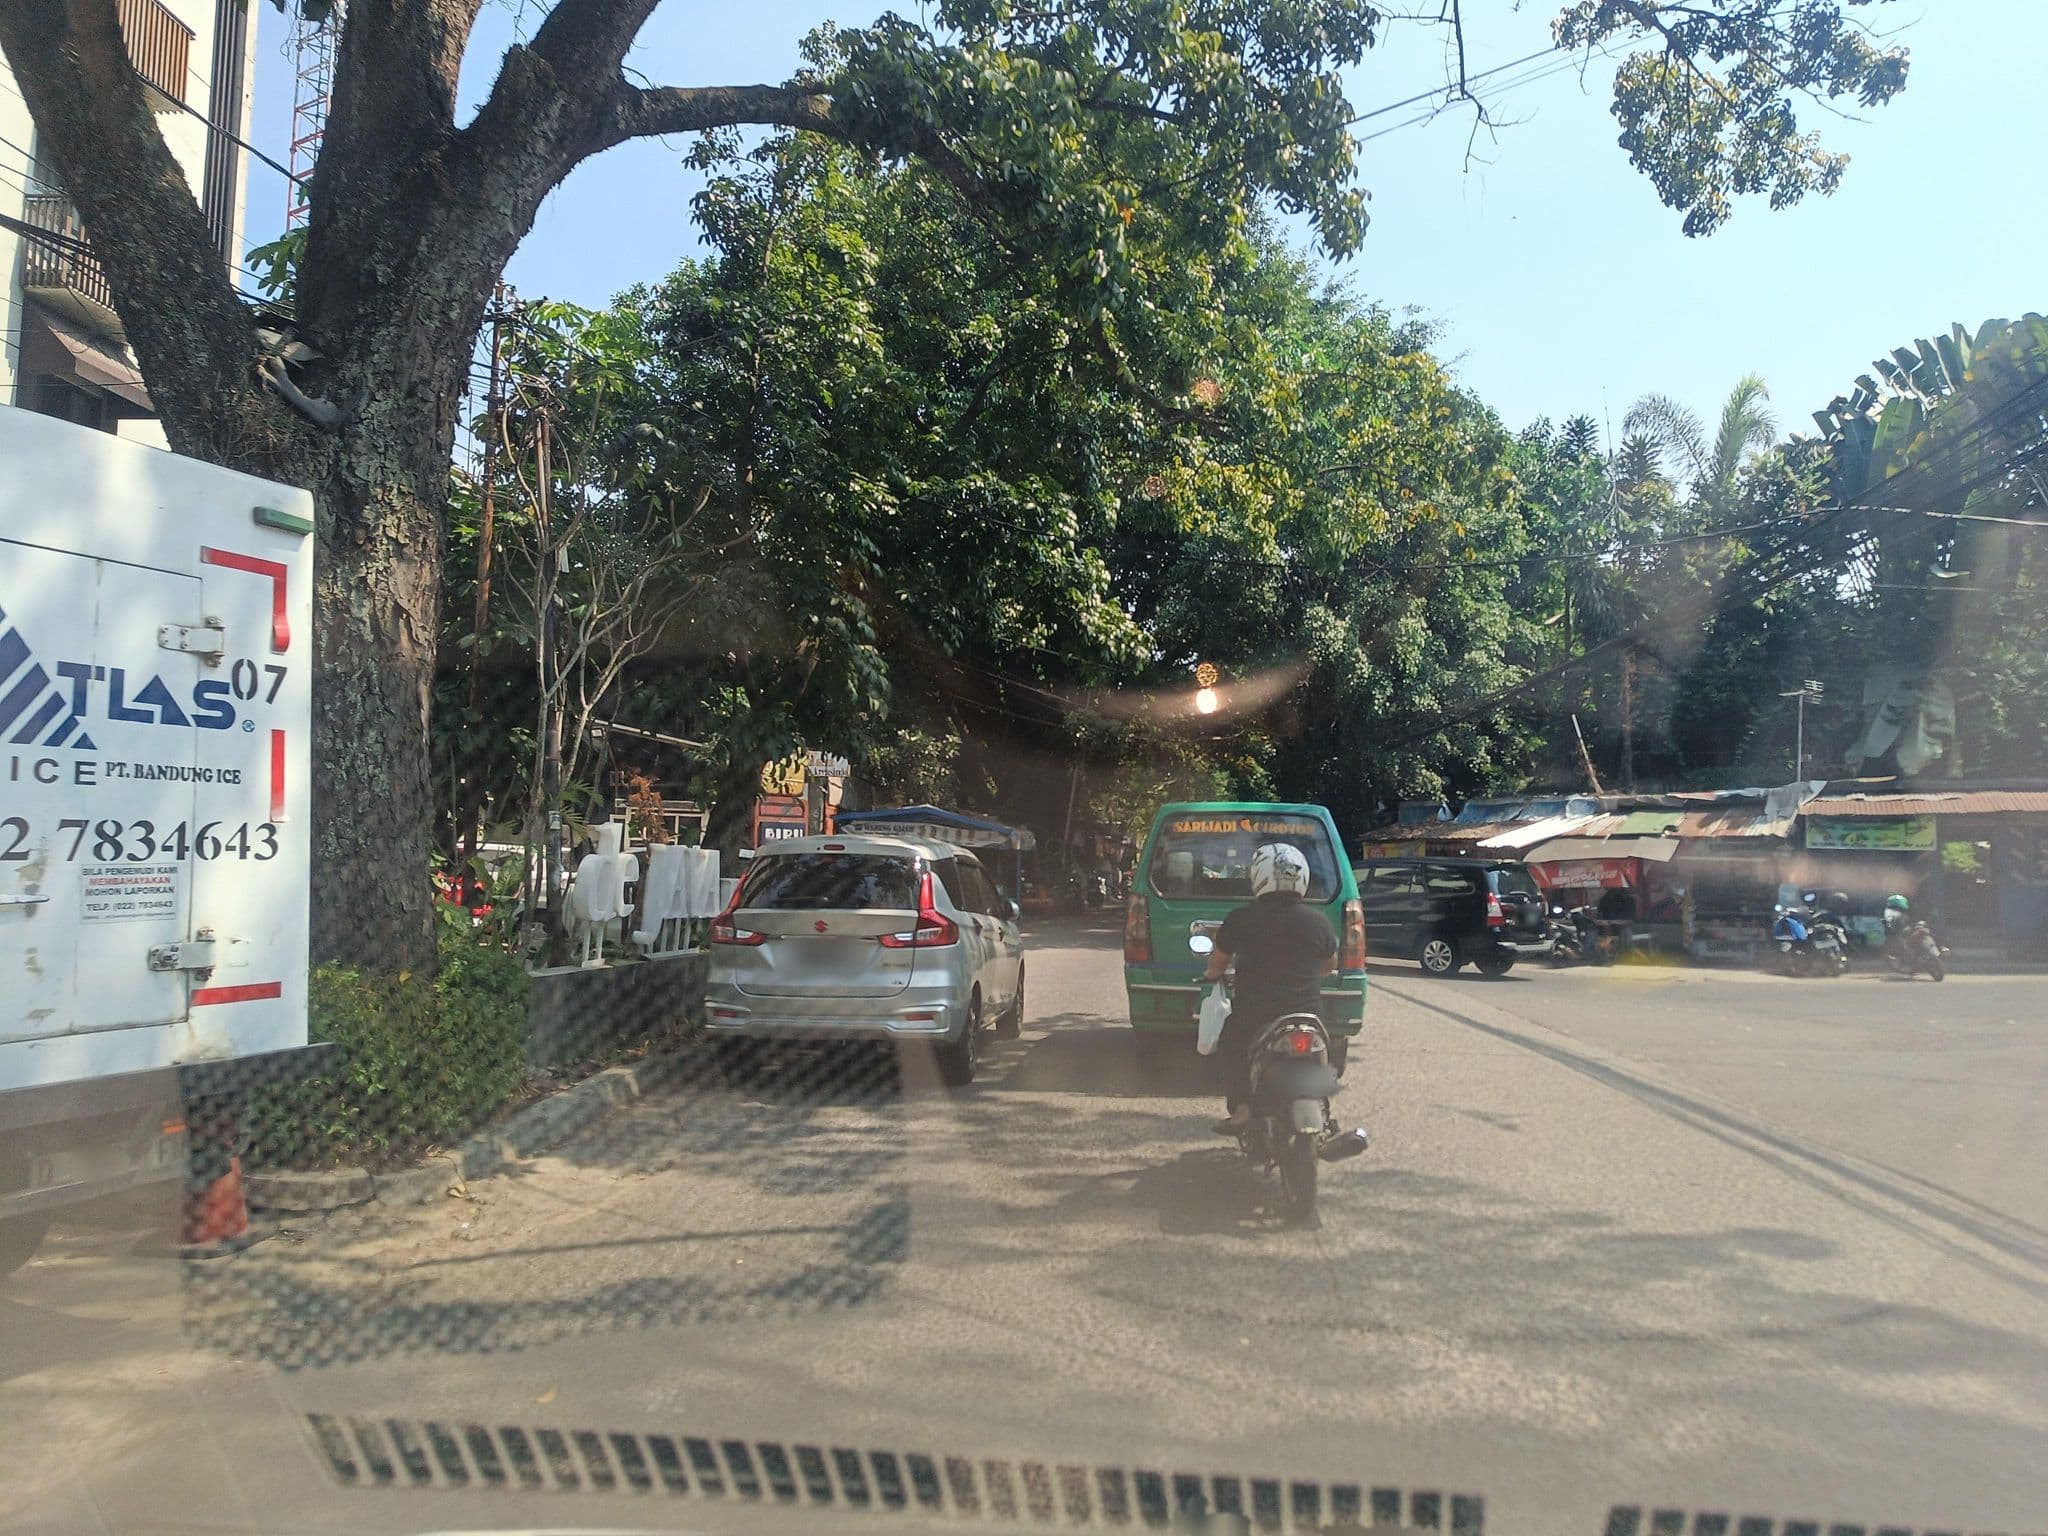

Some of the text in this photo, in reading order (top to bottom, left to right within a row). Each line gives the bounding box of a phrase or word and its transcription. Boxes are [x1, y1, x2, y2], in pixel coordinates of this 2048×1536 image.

[231, 658, 288, 704] 07
[104, 761, 241, 785] PT. BANDUNG ICE
[1174, 821, 1237, 833] SARIJADI
[56, 818, 279, 862] 7834643
[89, 877, 171, 886] MEMBAHAYAKAN
[85, 886, 175, 896] MOHON LAPORKAN
